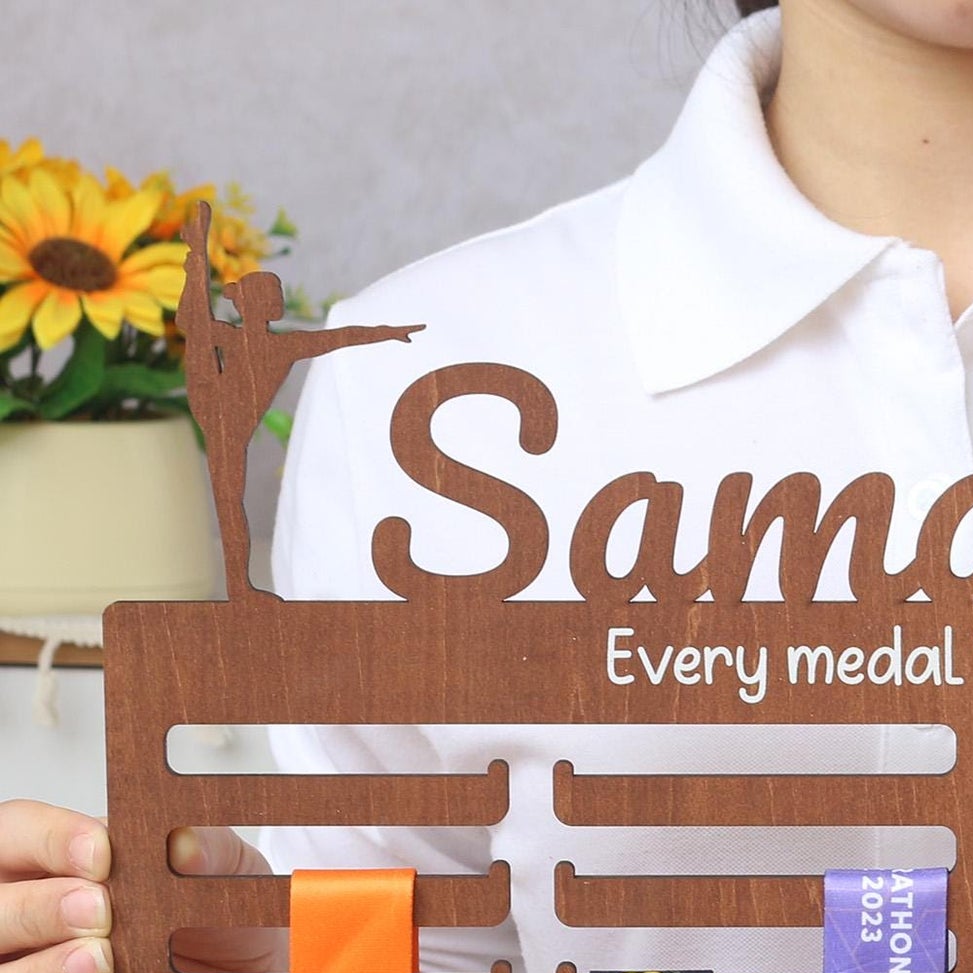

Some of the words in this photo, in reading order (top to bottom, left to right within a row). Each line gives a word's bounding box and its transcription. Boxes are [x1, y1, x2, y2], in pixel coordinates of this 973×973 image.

[606, 627, 768, 704] Every
[787, 625, 964, 686] medal
[861, 875, 884, 943] 2023
